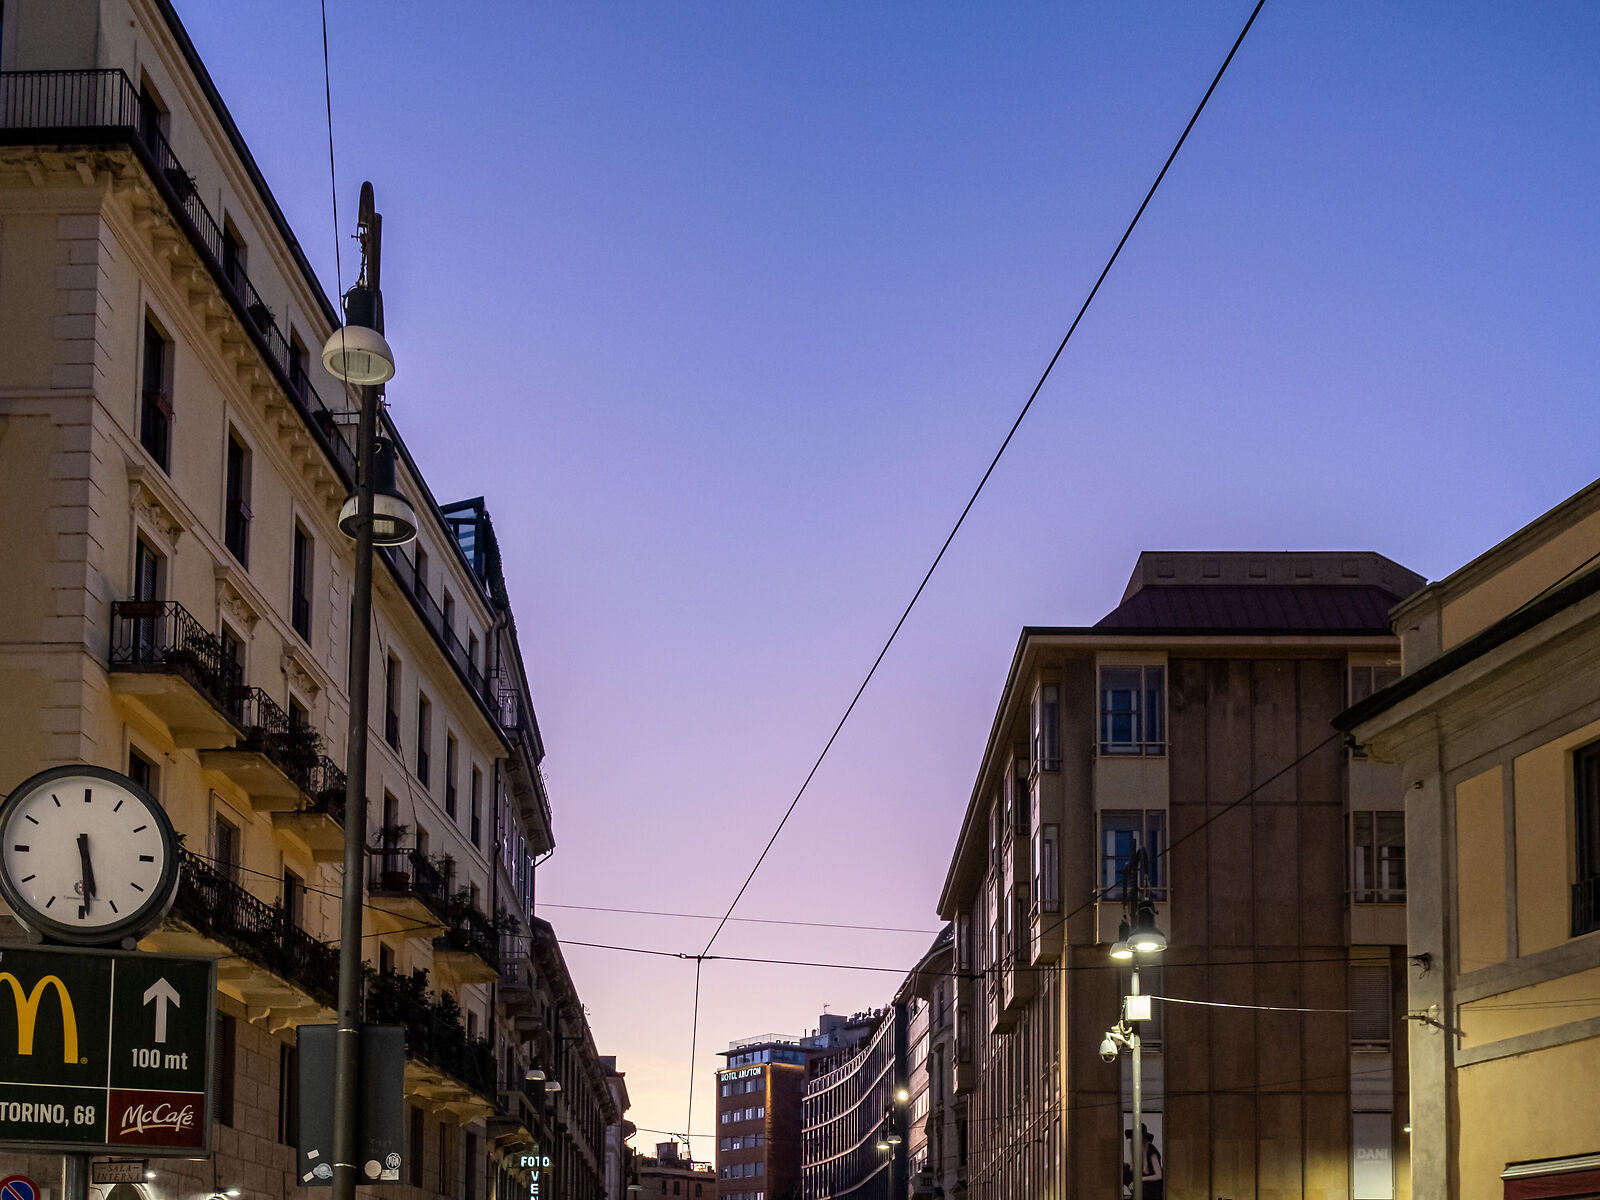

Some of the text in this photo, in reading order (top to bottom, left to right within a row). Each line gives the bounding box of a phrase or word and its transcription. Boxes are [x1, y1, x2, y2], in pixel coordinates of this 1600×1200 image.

[131, 1048, 188, 1070] 100 mt
[0, 1101, 96, 1127] TORINO, 68
[121, 1103, 194, 1133] McCafé
[1357, 1148, 1388, 1160] DANI
